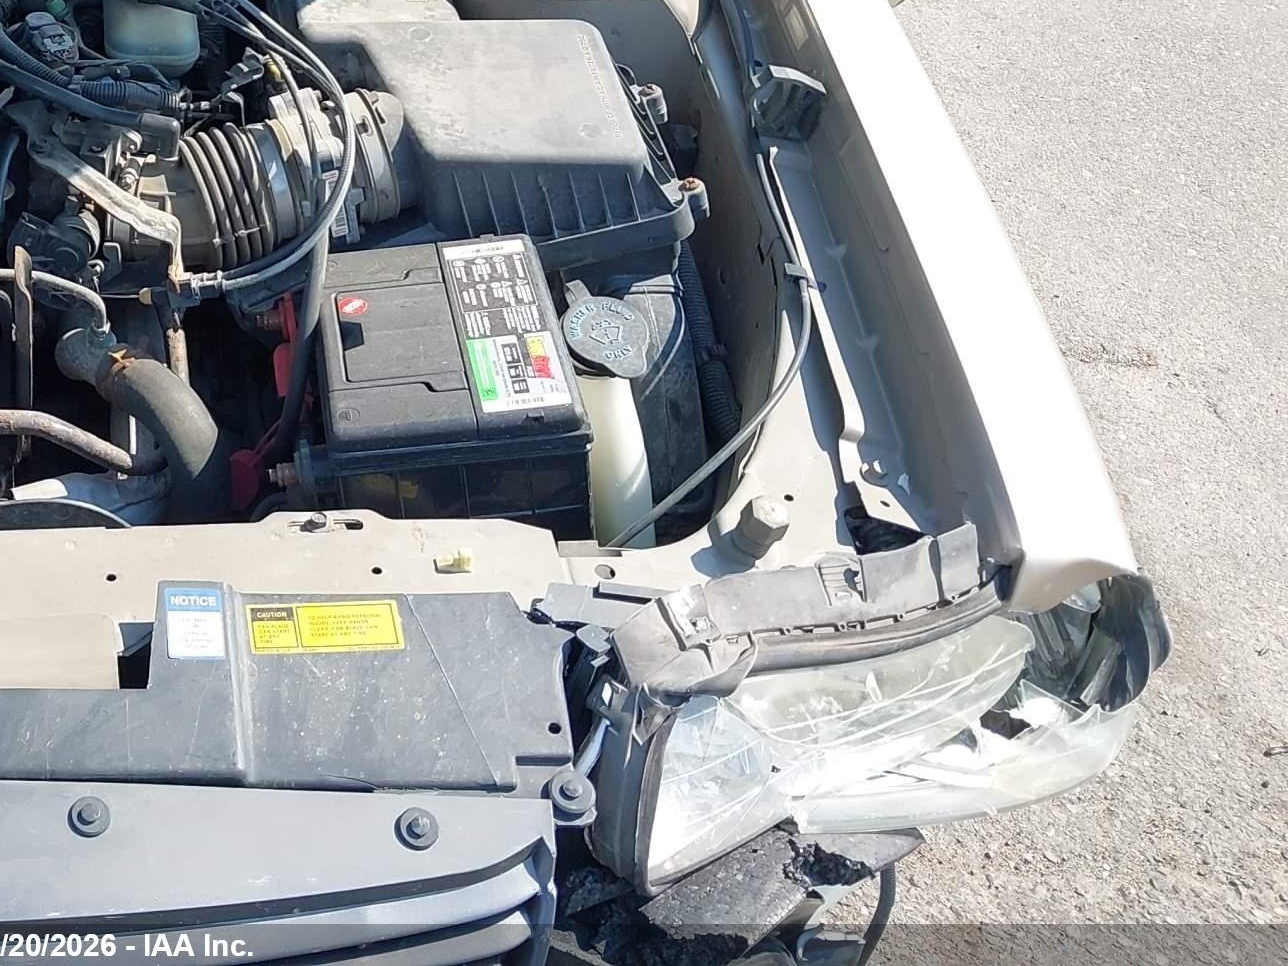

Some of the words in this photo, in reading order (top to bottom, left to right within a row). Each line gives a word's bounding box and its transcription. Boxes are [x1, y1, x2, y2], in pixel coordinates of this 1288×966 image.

[569, 303, 596, 339] WASHER
[600, 301, 634, 320] FLUID
[169, 595, 217, 606] NOTICE
